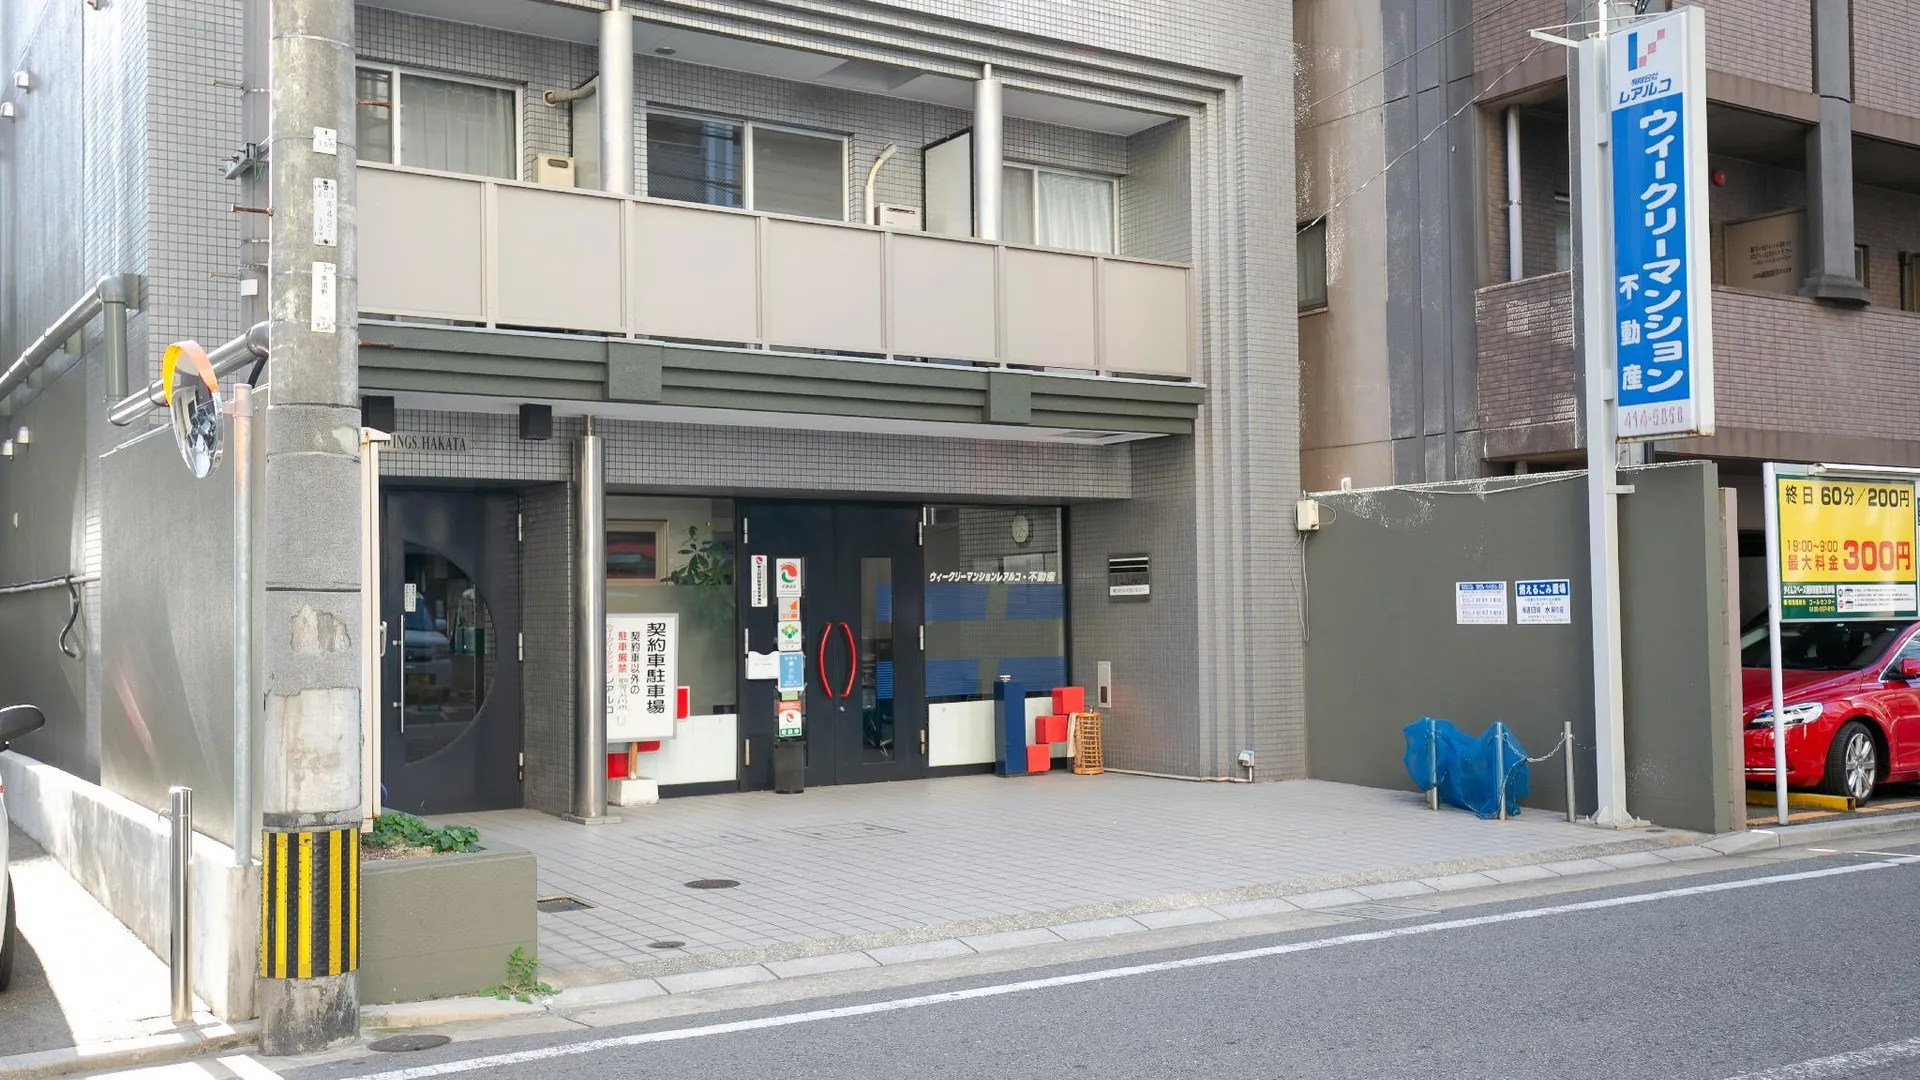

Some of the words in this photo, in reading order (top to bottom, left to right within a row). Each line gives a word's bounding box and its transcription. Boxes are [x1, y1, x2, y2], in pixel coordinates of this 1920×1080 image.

[1619, 78, 1672, 104] レアルコ
[1639, 109, 1684, 393] ウィークリーマンション
[1619, 273, 1643, 391] 不動産
[422, 436, 467, 451] HAKATA
[1785, 485, 1813, 505] 終日
[1788, 555, 1838, 571] 最大料金
[1843, 540, 1911, 571] 300円
[618, 631, 628, 673] 駐車厳禁
[630, 631, 641, 695] 契約車以外の
[646, 622, 666, 714] 契約車駐車場
